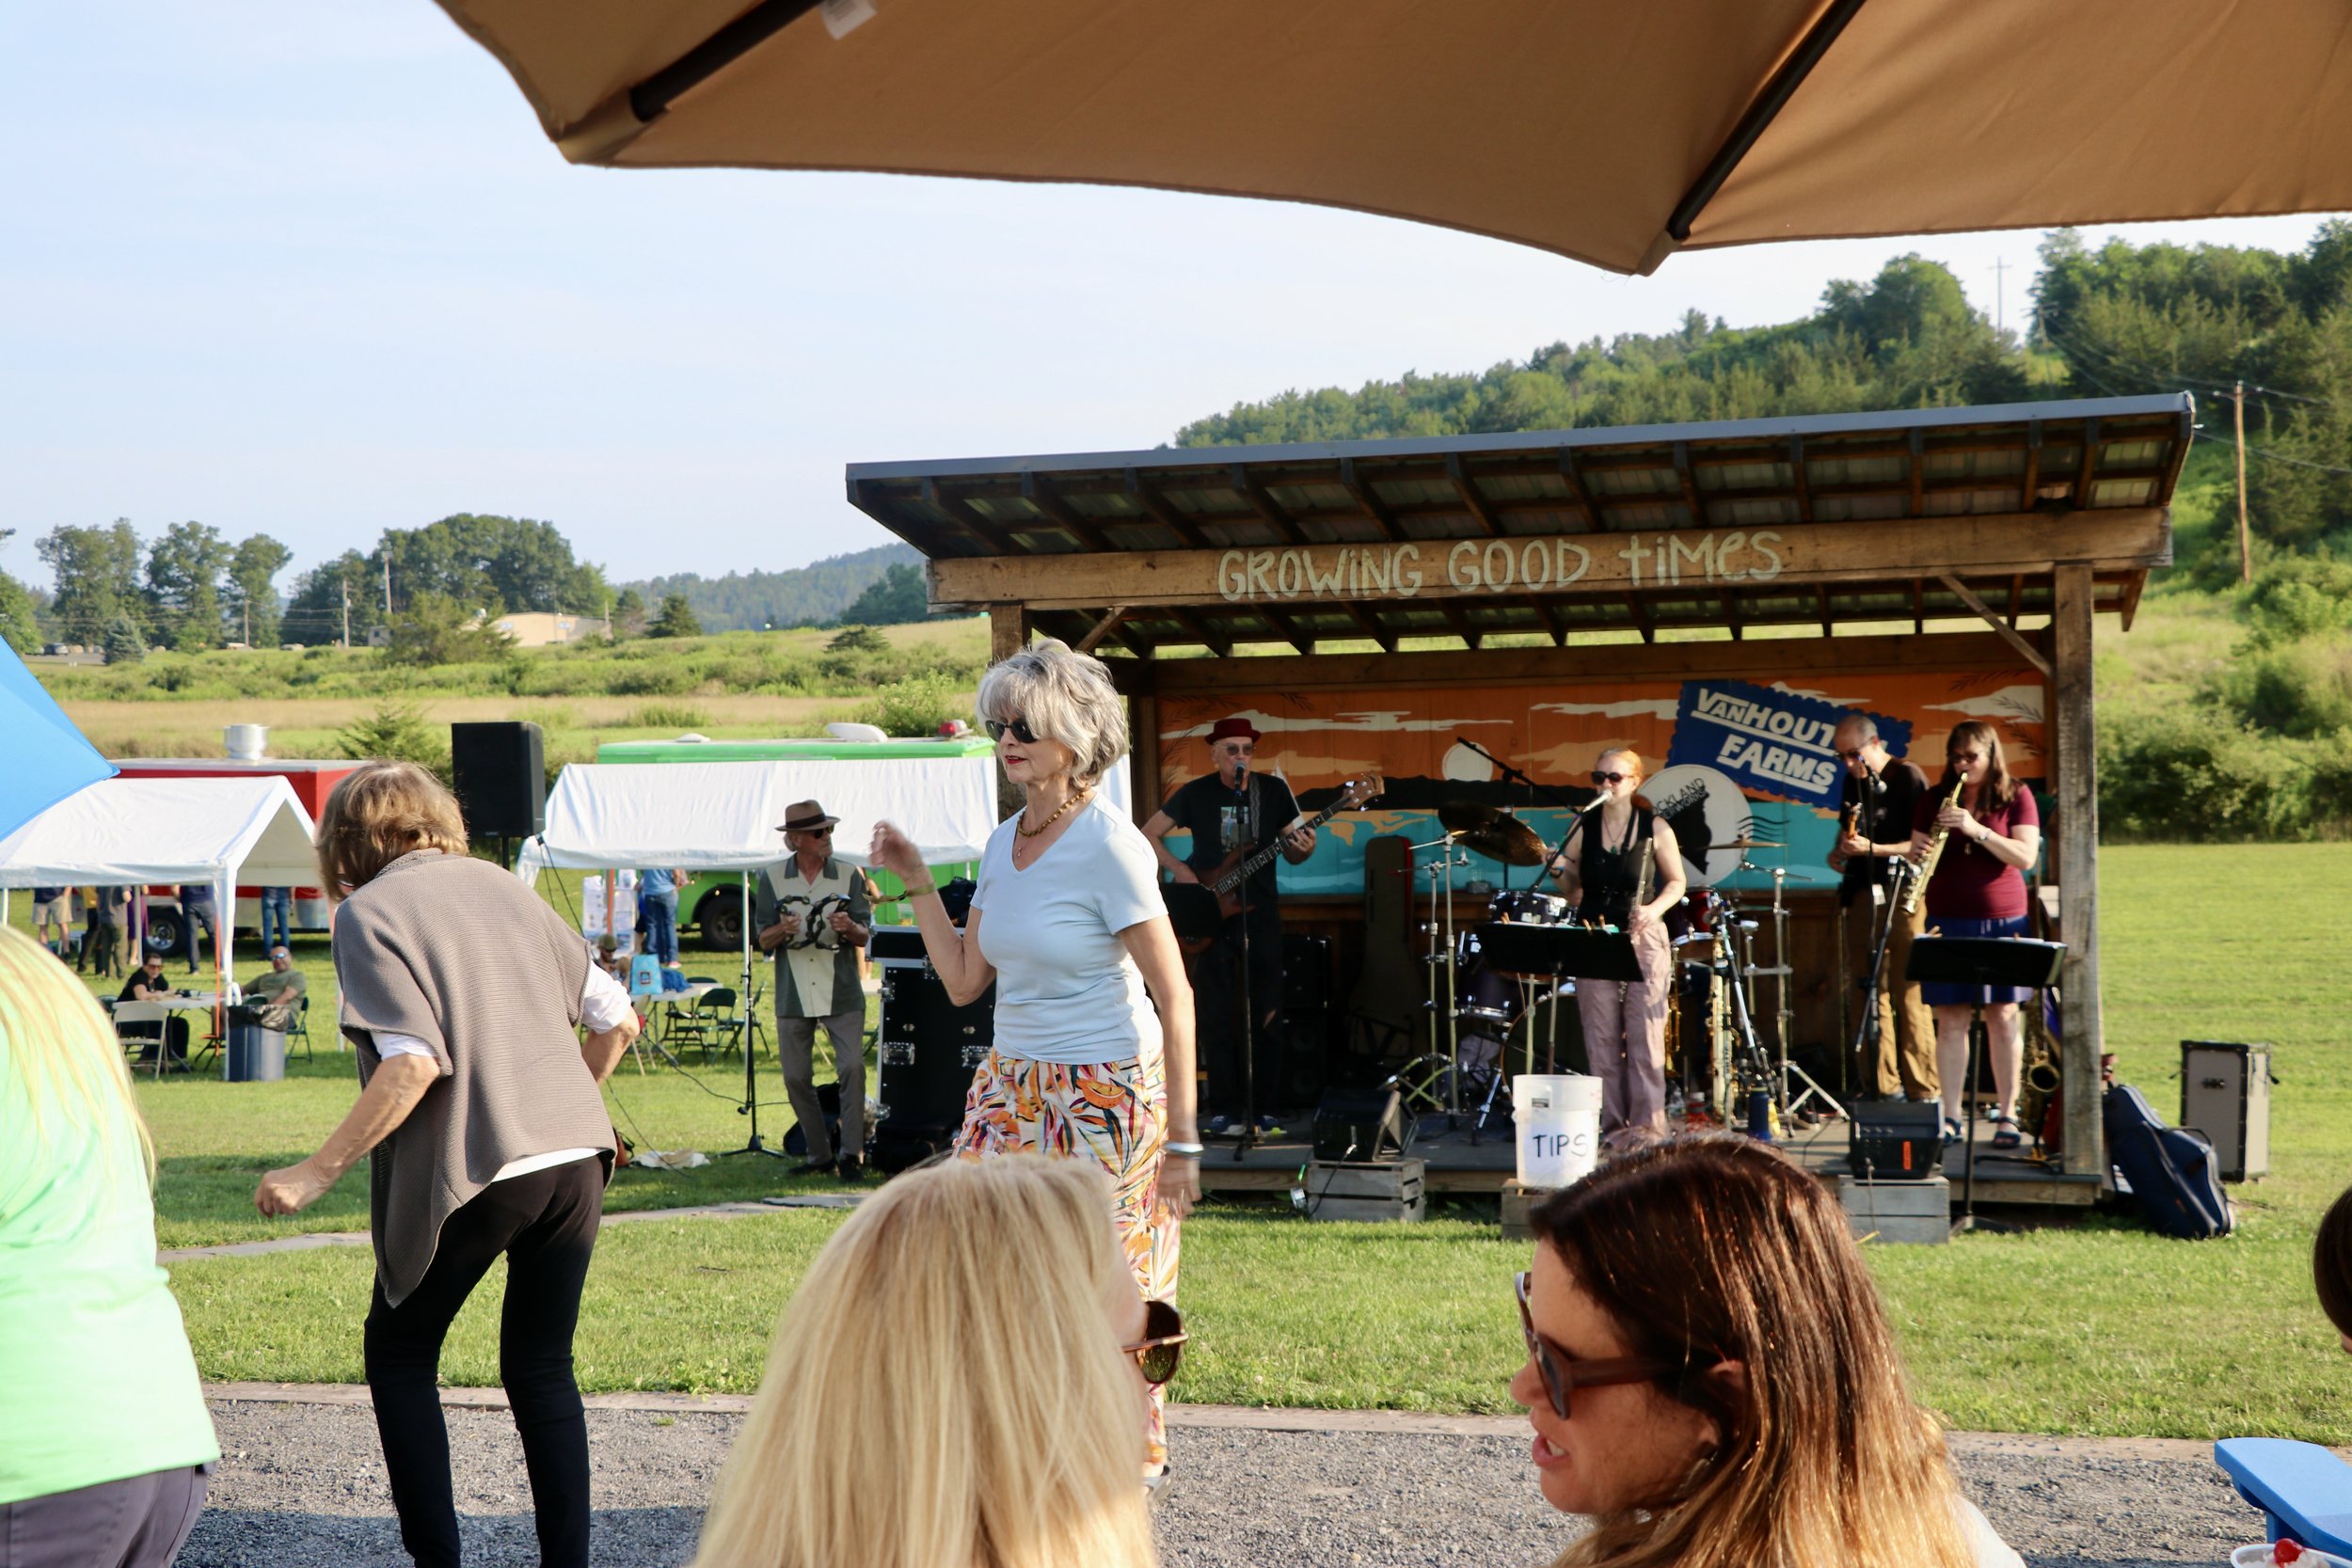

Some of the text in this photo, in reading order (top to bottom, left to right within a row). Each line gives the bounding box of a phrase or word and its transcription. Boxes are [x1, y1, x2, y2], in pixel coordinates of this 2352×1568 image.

[1448, 538, 1590, 593] GOOD
[1698, 688, 1888, 752] VANHOUT
[1718, 734, 1836, 790] FARMS
[1662, 788, 1708, 819] ERWORKS
[1533, 1133, 1588, 1157] TIPS
